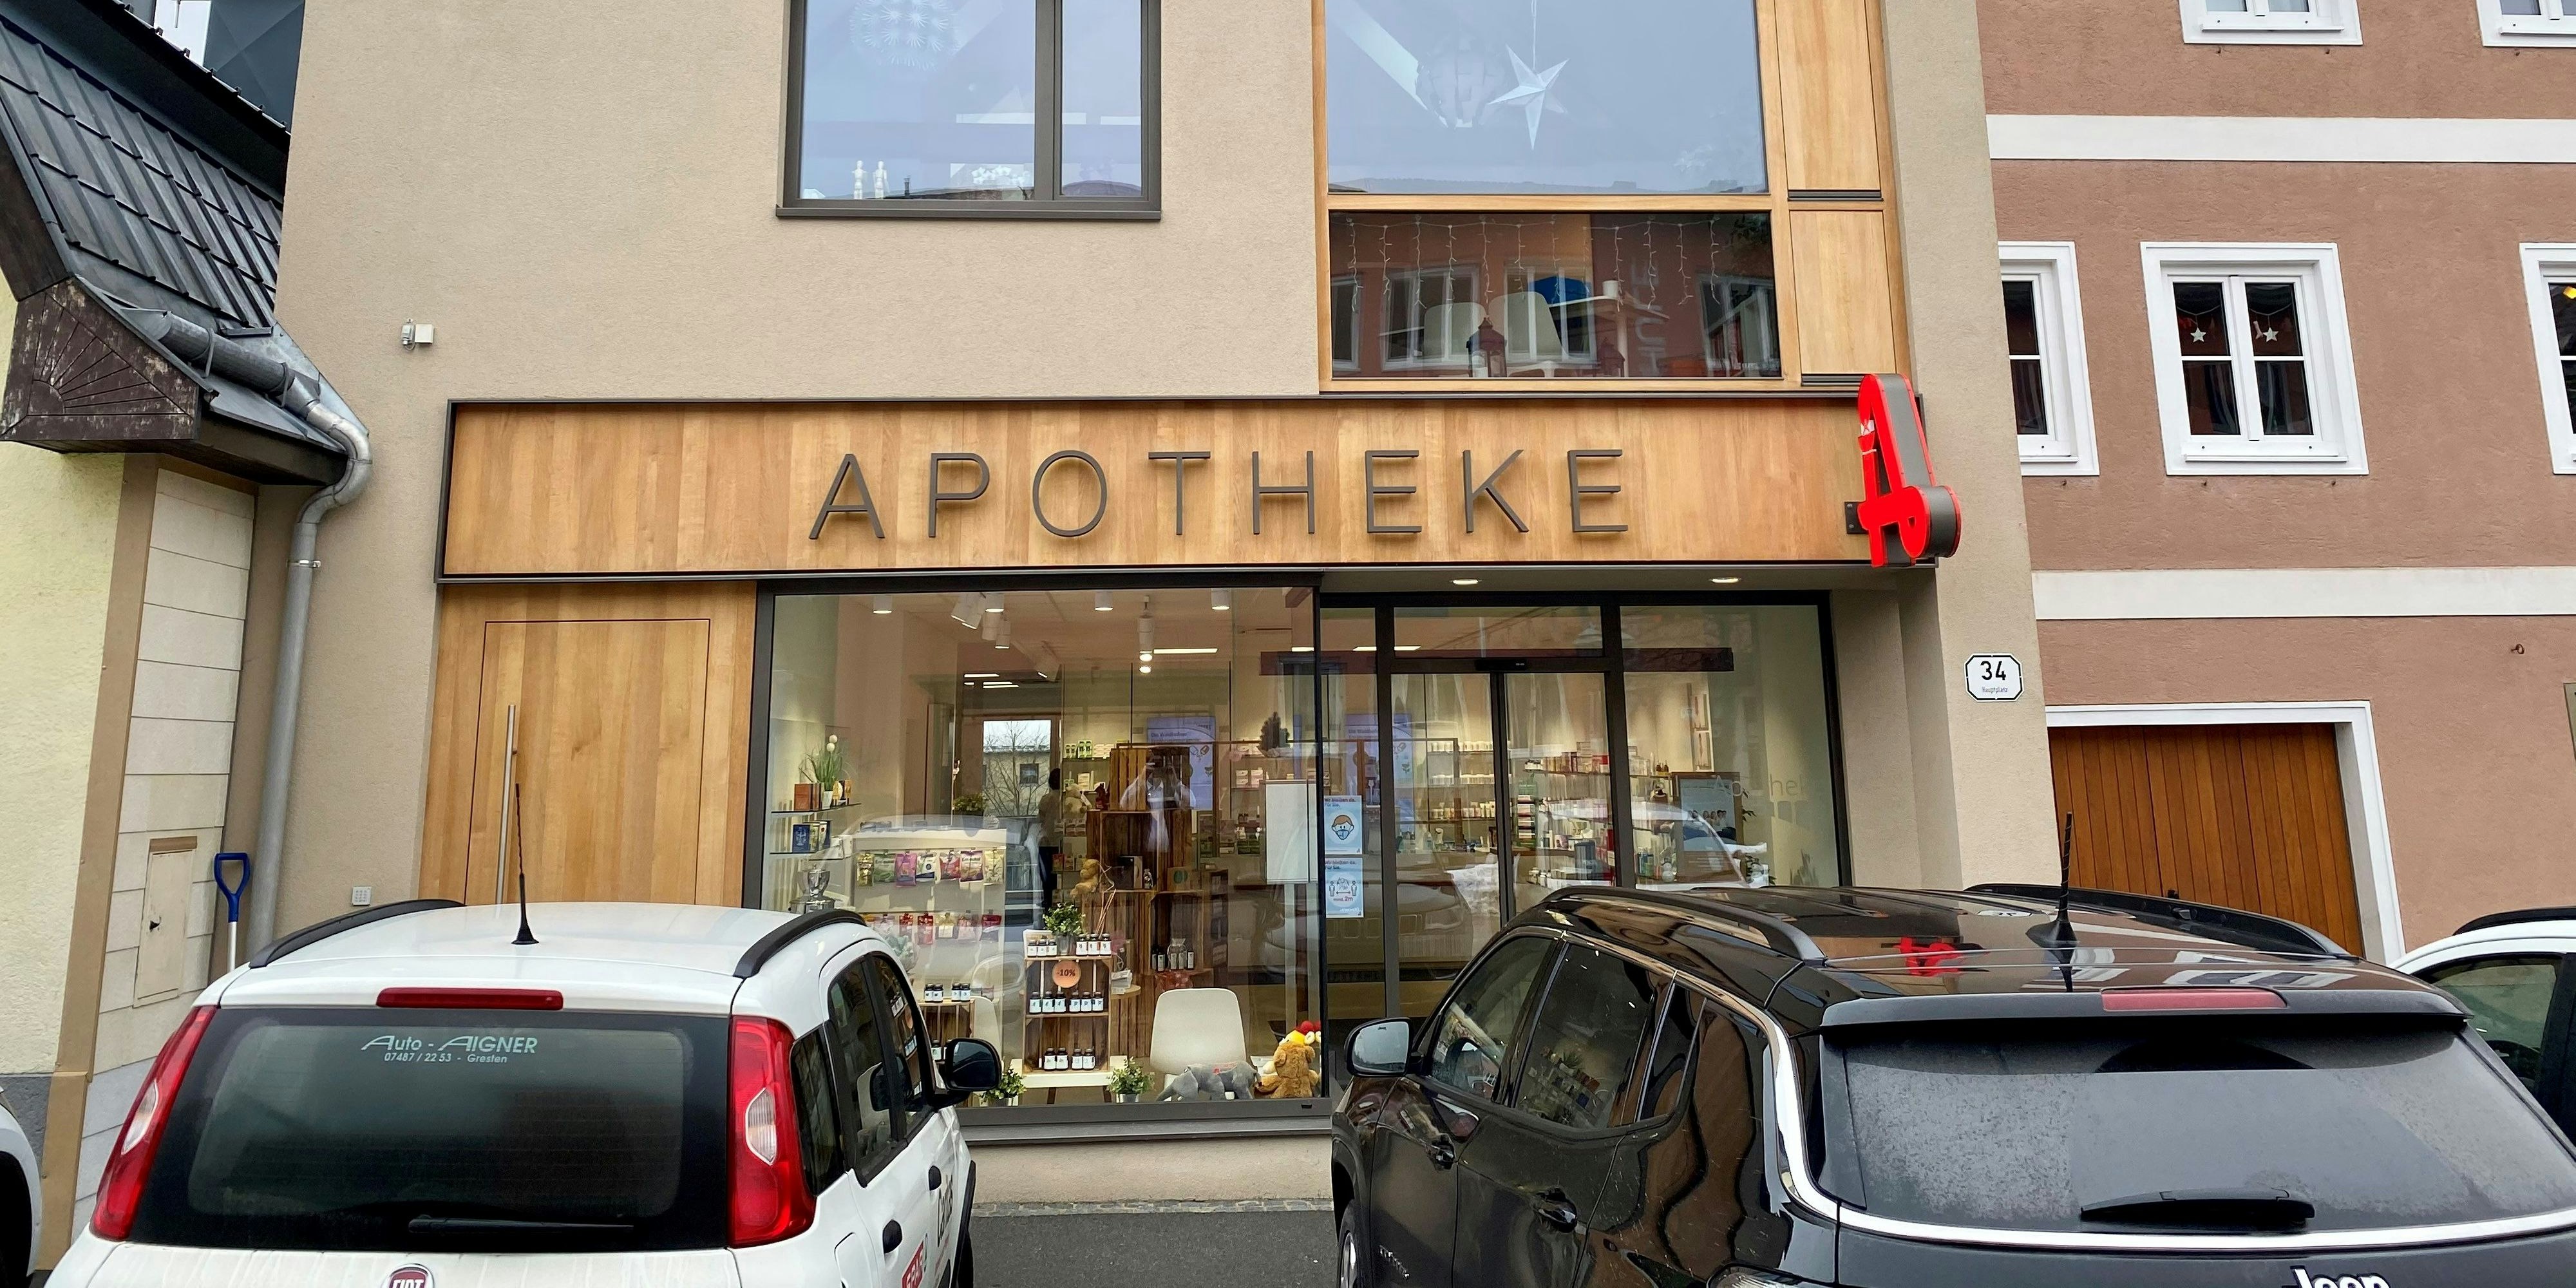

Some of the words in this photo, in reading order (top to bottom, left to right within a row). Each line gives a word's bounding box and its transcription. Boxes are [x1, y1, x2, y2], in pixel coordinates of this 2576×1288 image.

[810, 449, 1629, 539] APOTHEKE
[1980, 660, 2007, 681] 34
[1056, 969, 1076, 977] -10%
[361, 1035, 422, 1051] Auto
[437, 1035, 538, 1054] AIGNER
[384, 1052, 415, 1063] 07487
[424, 1053, 437, 1063] 22
[438, 1053, 451, 1063] 53
[466, 1054, 507, 1063] Gresten
